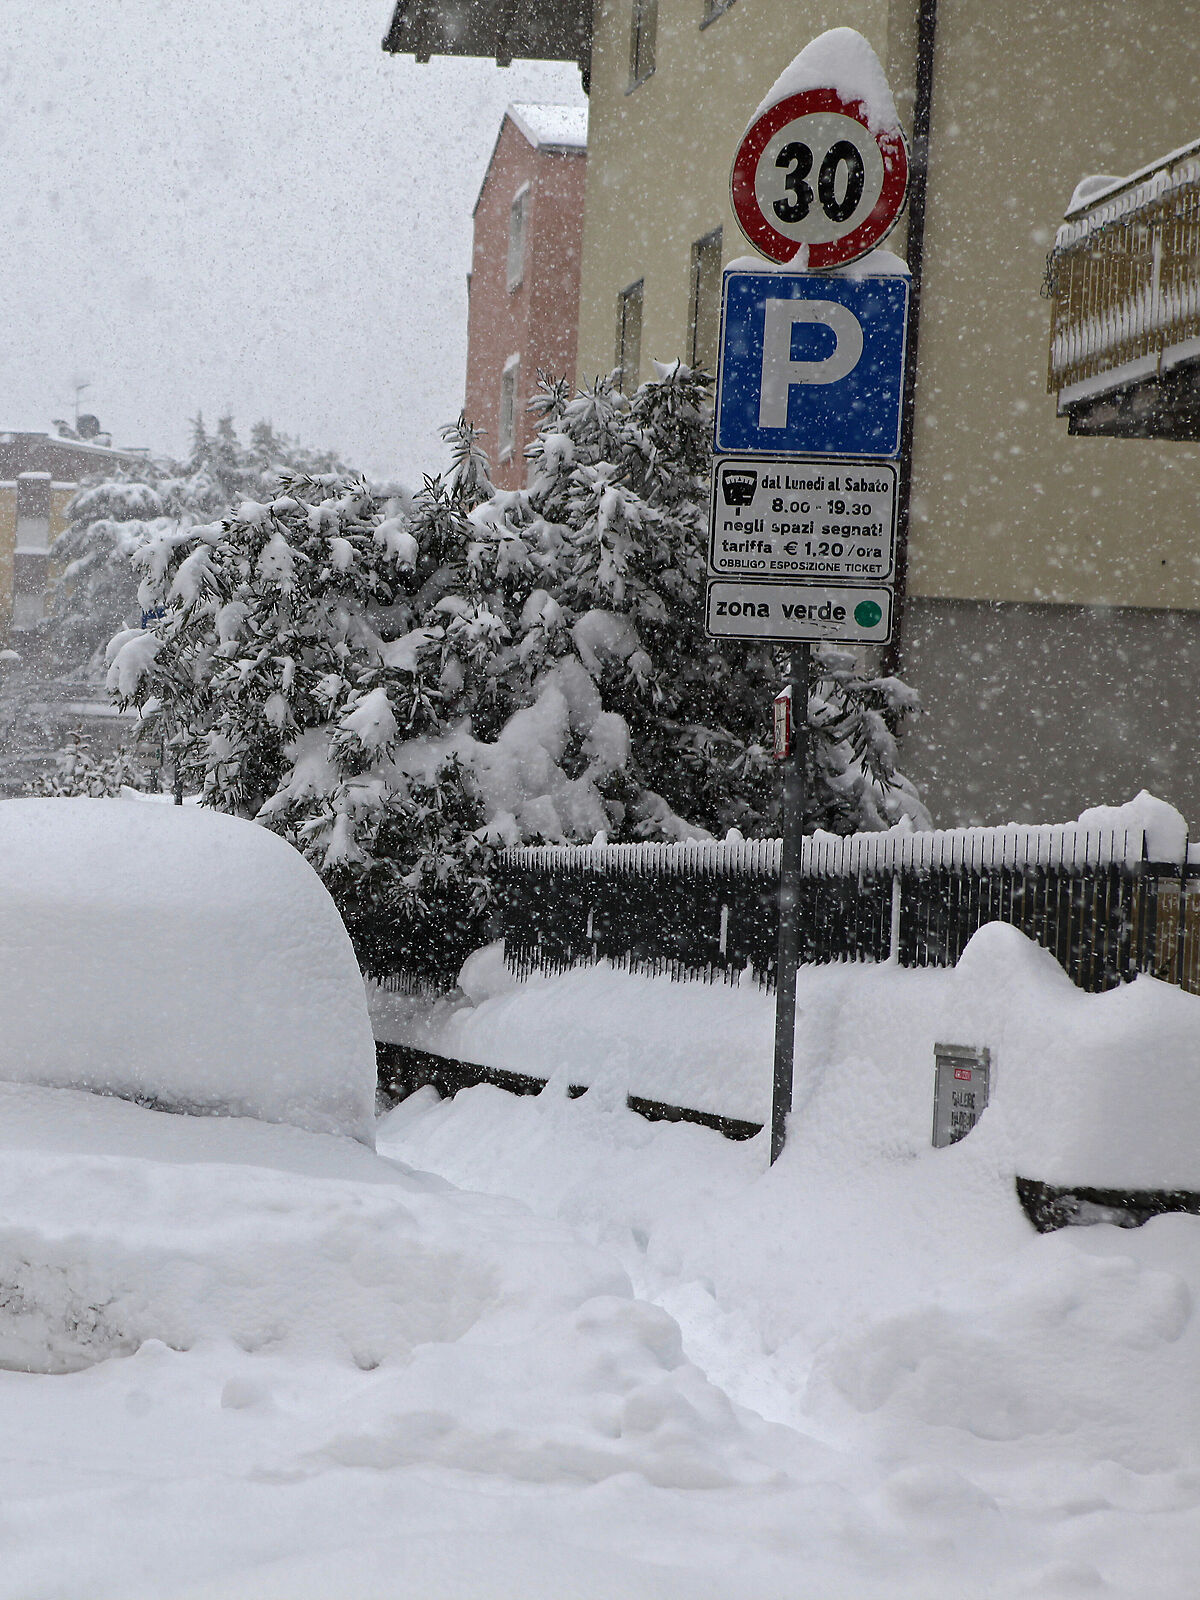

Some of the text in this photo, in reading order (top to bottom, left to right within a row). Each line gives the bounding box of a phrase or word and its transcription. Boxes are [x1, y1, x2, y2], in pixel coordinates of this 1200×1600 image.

[773, 140, 864, 223] 30
[759, 299, 863, 428] P
[762, 475, 888, 492] dal Lunedi al Sabato
[772, 498, 810, 513] 8.00
[827, 500, 872, 515] 19.30
[724, 519, 882, 537] negli spazi segnati
[722, 540, 772, 553] tariffa
[784, 541, 798, 555] €
[720, 559, 882, 573] OBBLIGO ESPOSIZIONE TICKET
[716, 601, 846, 620] zona verde
